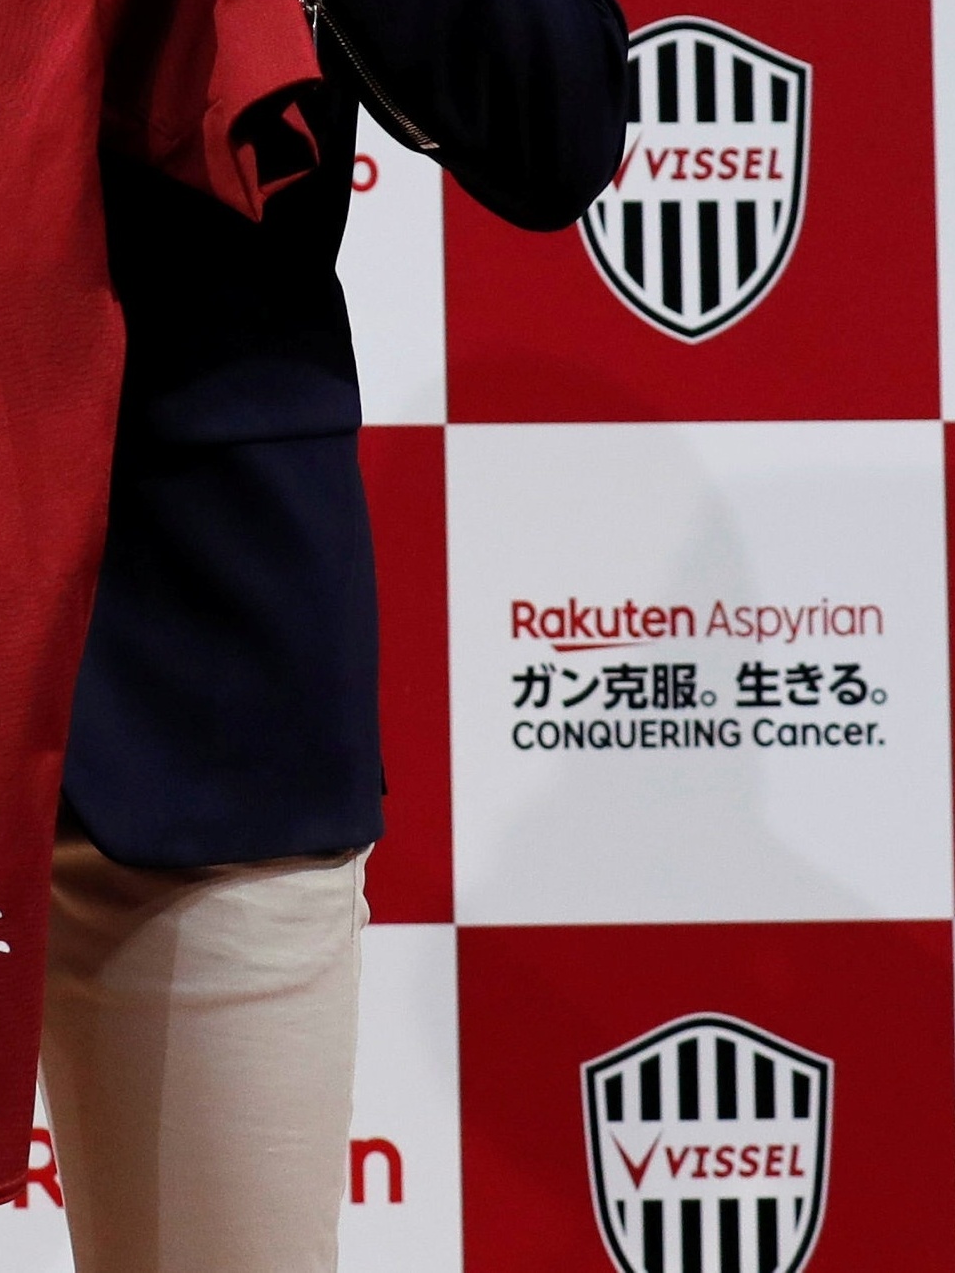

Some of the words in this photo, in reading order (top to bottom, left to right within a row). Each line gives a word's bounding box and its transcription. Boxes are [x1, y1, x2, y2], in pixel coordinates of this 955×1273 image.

[644, 147, 783, 182] VISSEL
[511, 597, 696, 640] Rakuten
[706, 599, 885, 644] Aspyrian
[512, 662, 717, 711] ガン克服。
[735, 660, 887, 709] 生きる。
[511, 718, 742, 751] CONQUERING
[752, 717, 886, 748] Cancer.
[664, 1143, 806, 1180] VISSEL
